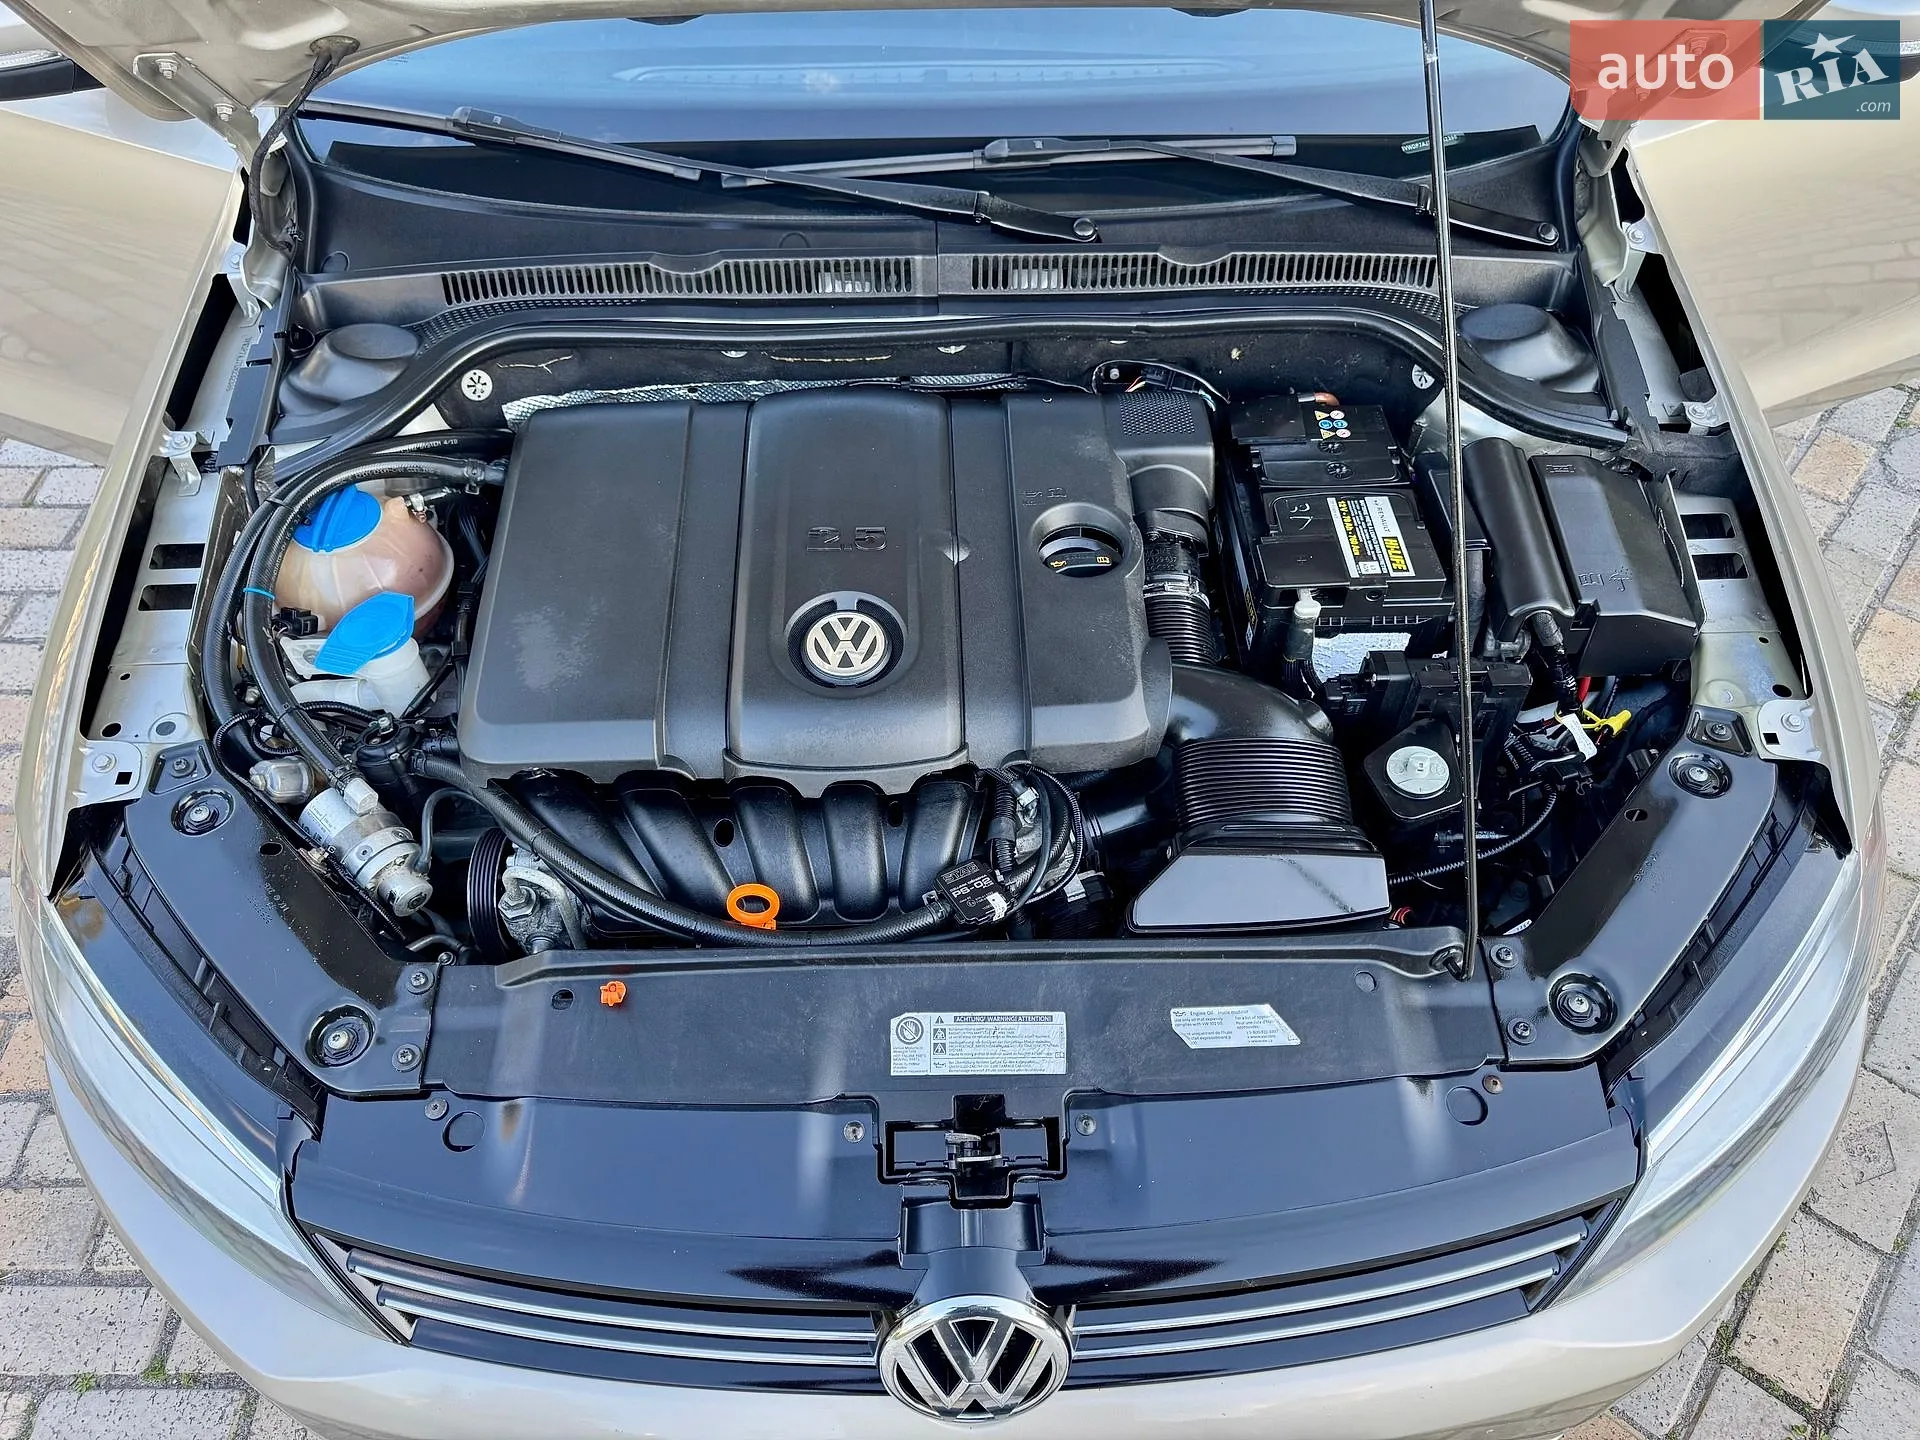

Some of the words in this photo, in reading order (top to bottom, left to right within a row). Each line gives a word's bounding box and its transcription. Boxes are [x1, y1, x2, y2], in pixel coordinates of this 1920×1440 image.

[1376, 507, 1391, 532] RENAULT
[806, 526, 887, 552] 2.5
[1383, 538, 1407, 571] HI-LIFE
[956, 1015, 986, 1023] ACHTUNG!
[987, 1015, 1017, 1023] WARNING!
[1017, 1015, 1051, 1023] ATTENTION!
